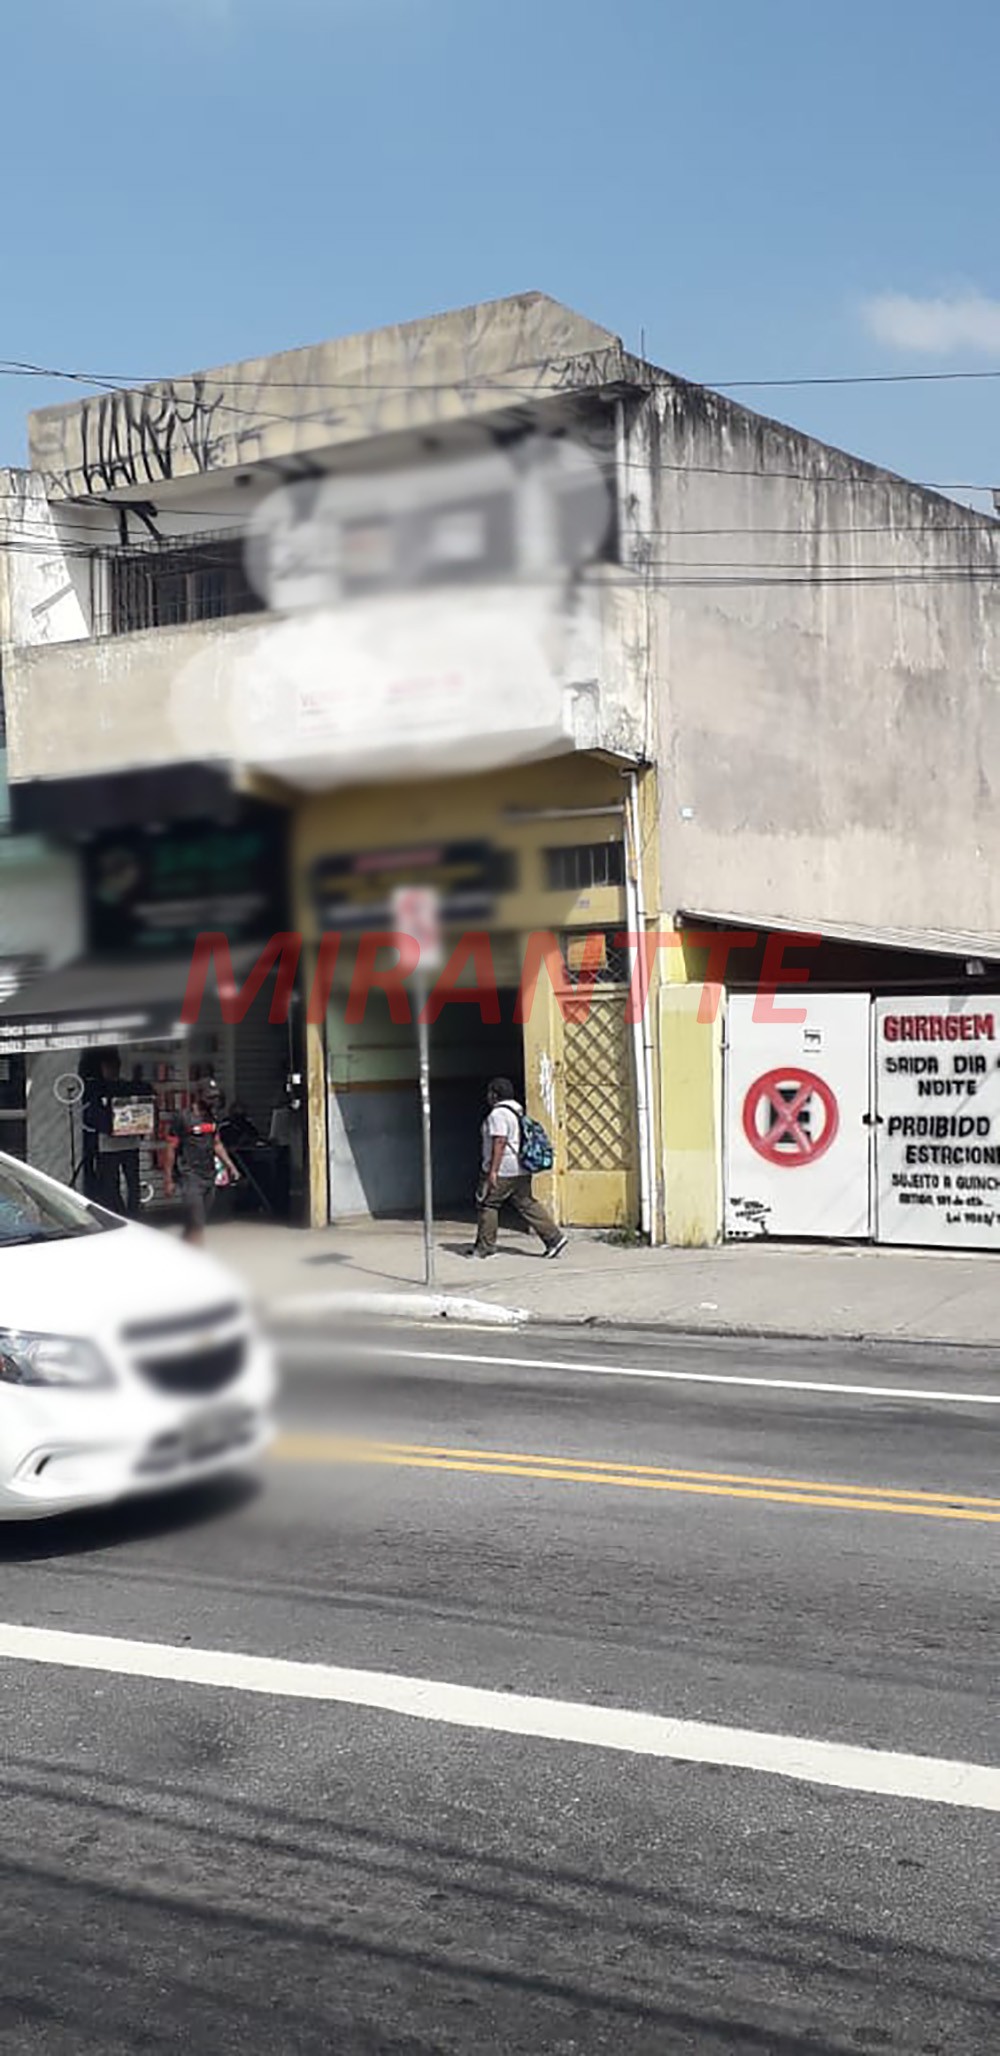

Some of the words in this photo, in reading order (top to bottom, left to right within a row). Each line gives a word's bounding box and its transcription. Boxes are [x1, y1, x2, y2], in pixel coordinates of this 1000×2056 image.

[884, 1014, 995, 1042] GARAGEM
[953, 1055, 987, 1074] DIA
[917, 1080, 977, 1096] NOITE
[888, 1116, 990, 1138] PROIBIDO
